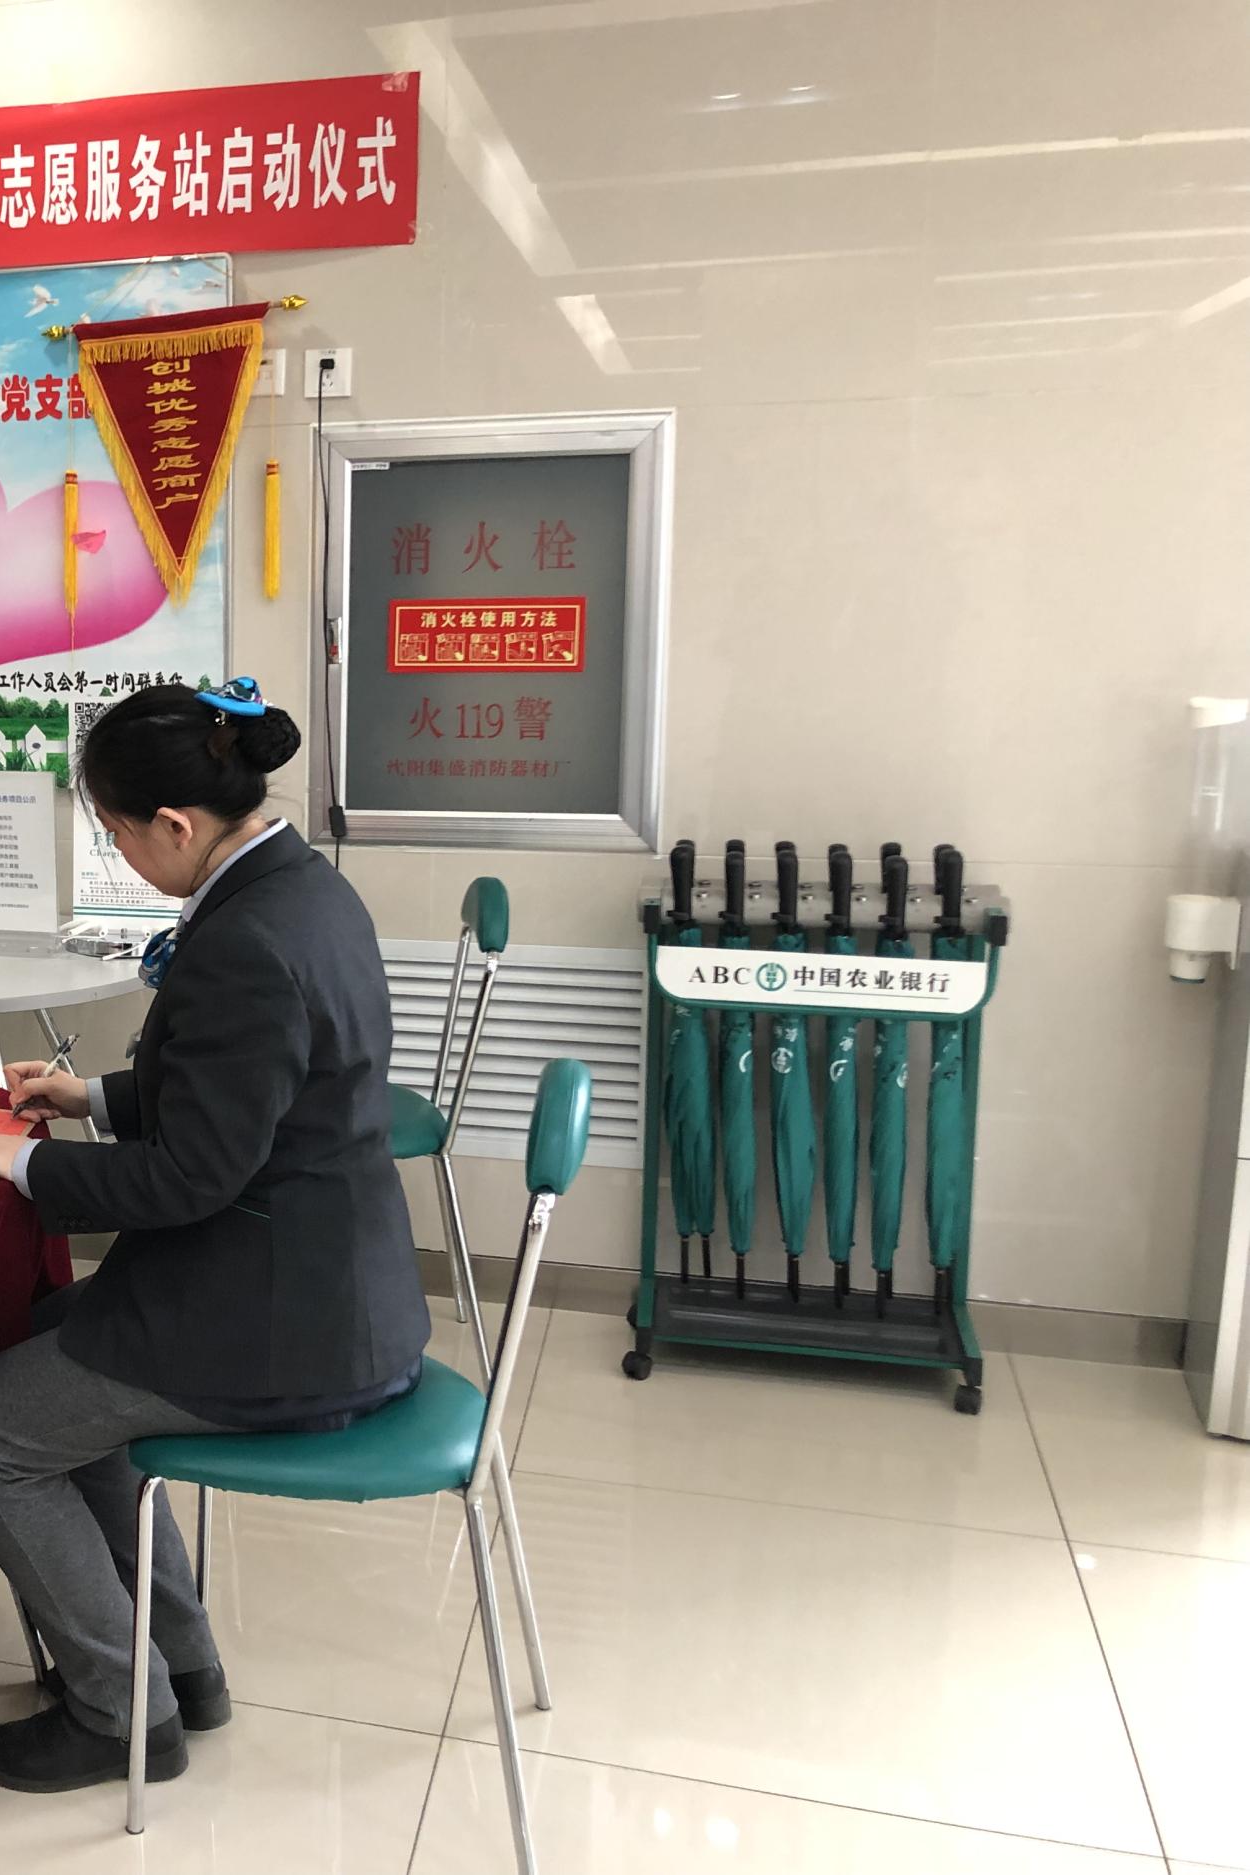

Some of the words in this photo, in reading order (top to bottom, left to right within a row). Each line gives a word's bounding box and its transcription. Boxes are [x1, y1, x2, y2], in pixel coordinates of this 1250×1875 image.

[391, 519, 577, 575] 消火栓
[420, 610, 558, 628] 消火栓使用方法
[688, 966, 751, 985] ABC
[793, 966, 950, 993] 中国农业银行
